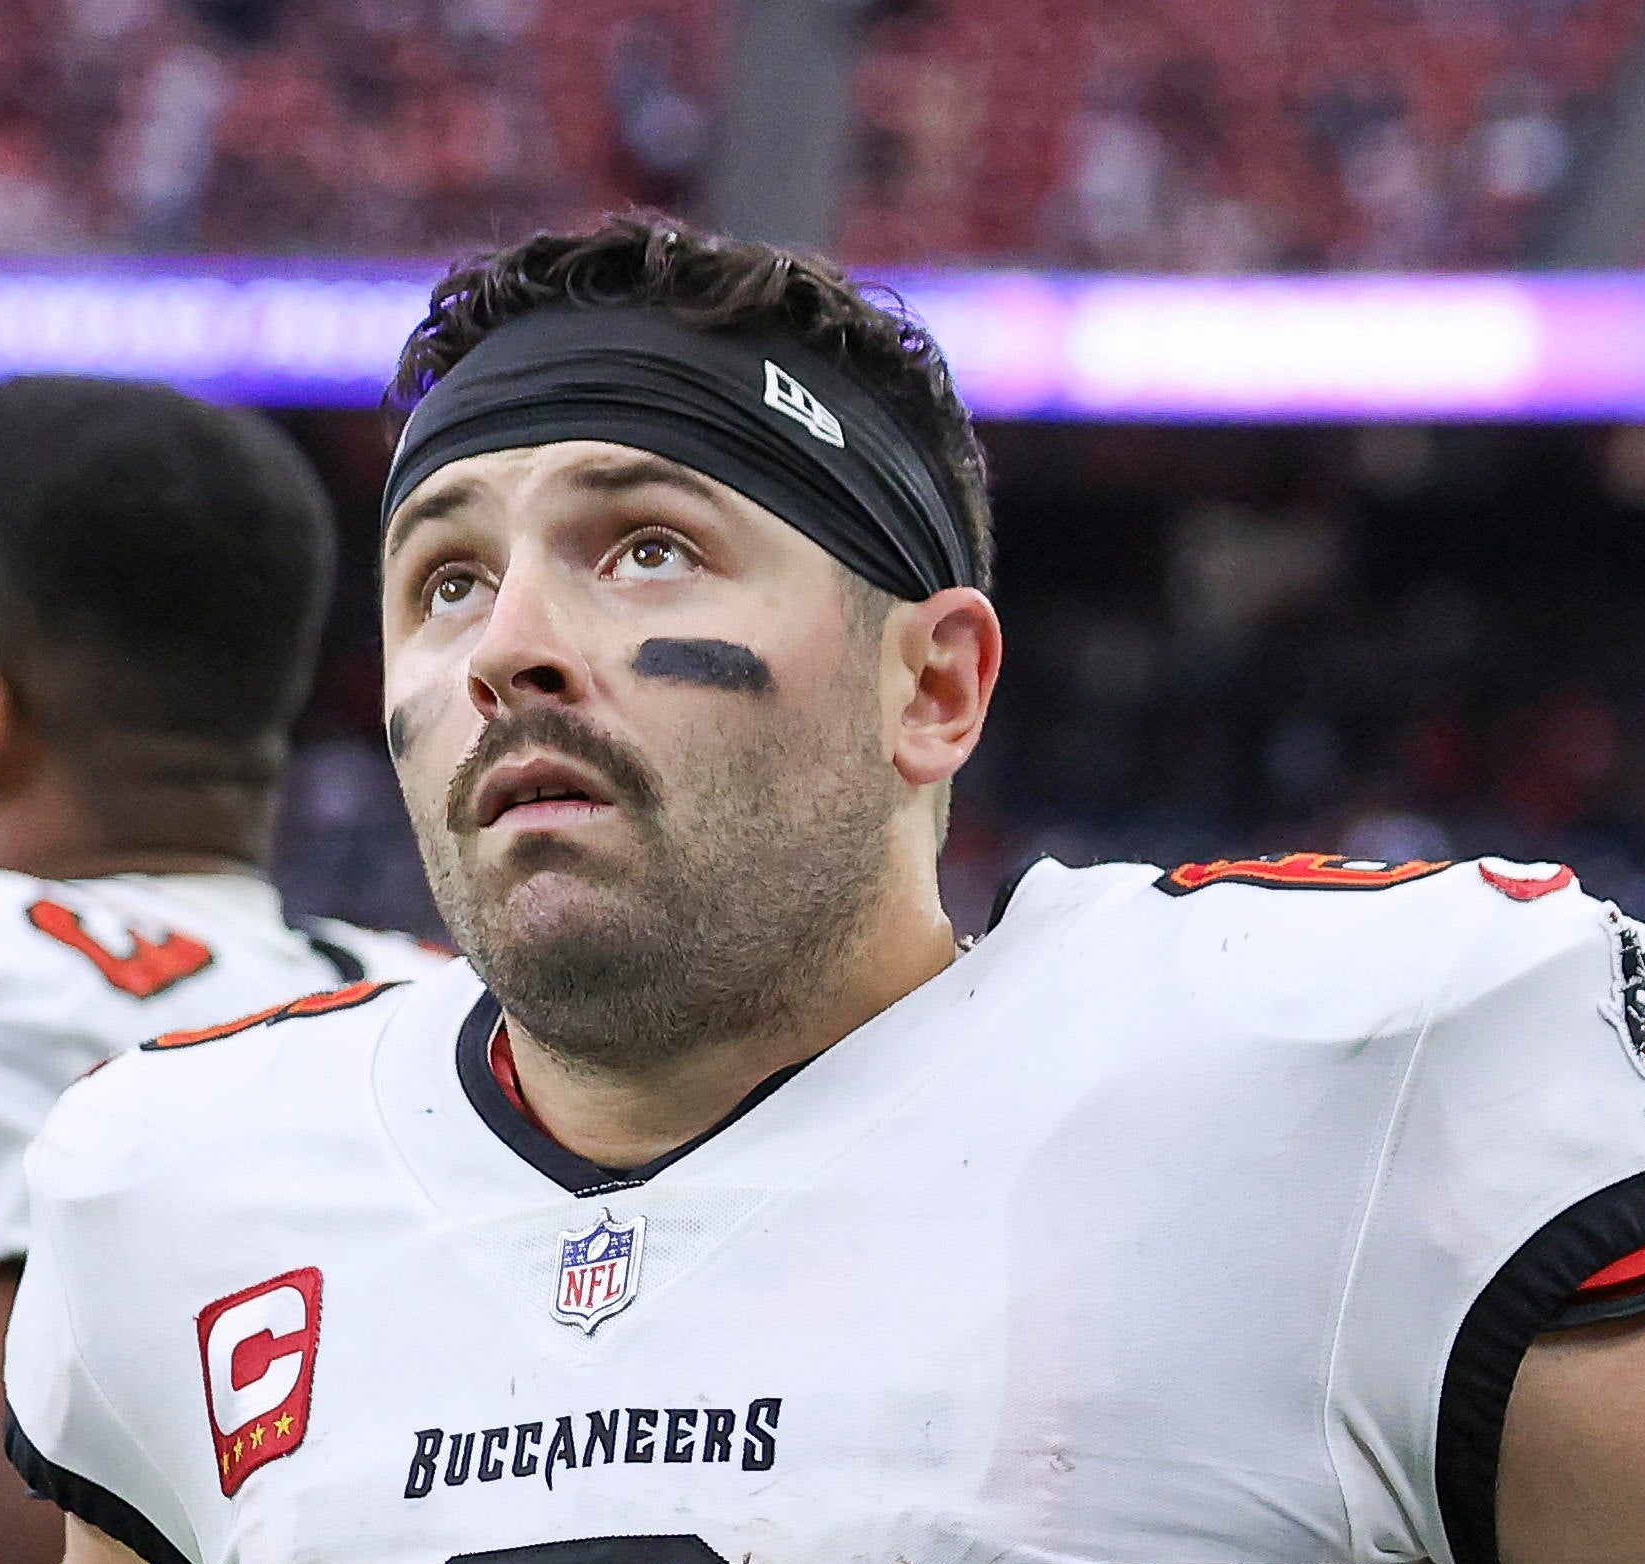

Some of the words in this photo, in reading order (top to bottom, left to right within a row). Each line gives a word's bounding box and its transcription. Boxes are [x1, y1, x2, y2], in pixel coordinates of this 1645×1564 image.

[563, 1261, 621, 1309] NFL
[206, 1284, 307, 1437] C
[404, 1397, 782, 1499] BUCCANEERS
